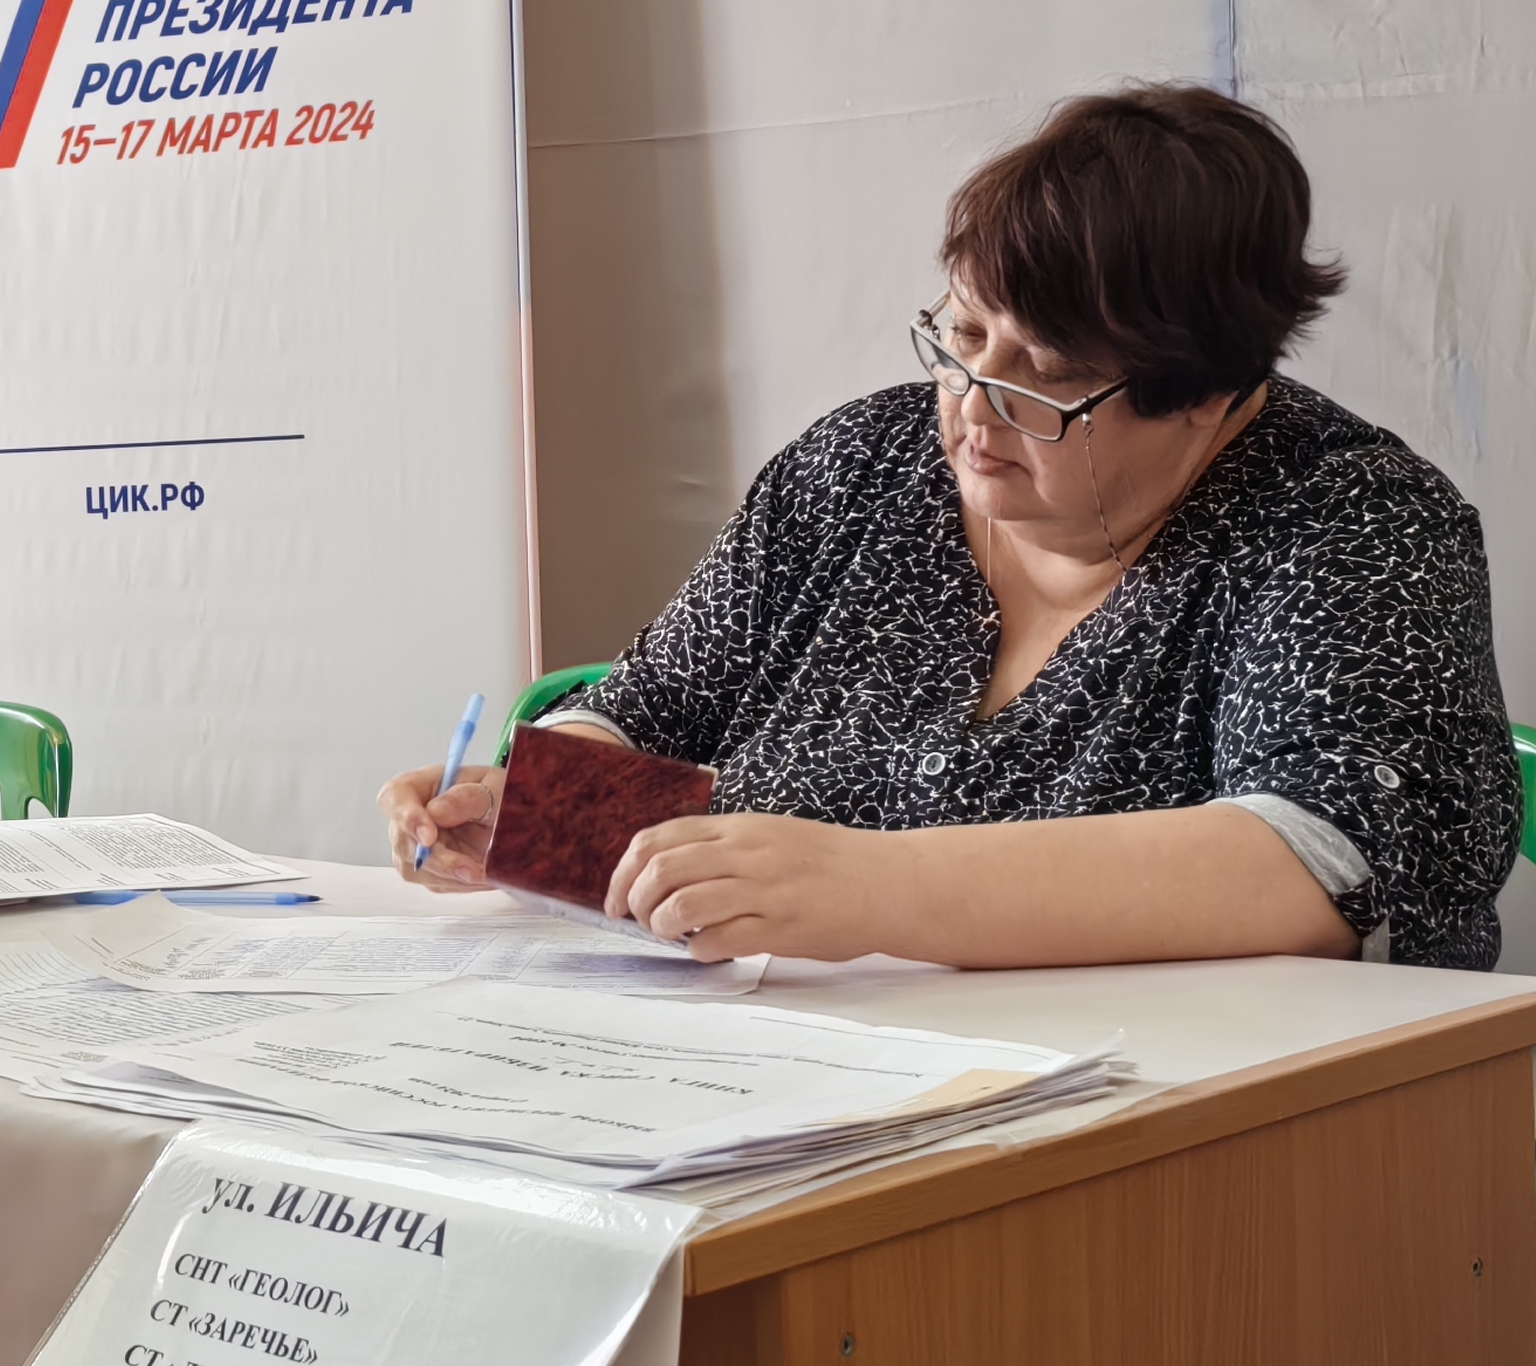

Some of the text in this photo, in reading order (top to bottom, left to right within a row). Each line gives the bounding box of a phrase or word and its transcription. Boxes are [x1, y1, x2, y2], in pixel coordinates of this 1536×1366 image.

[72, 46, 278, 109] РОССИИ
[156, 107, 279, 156] МАРТА
[285, 100, 375, 147] 2024
[85, 481, 205, 519] ЦИК.РФ
[201, 1177, 448, 1258] ул. ИЛЬИЧА
[150, 1298, 187, 1327] СТ
[173, 1252, 350, 1319] СНТ «ГЕОЛОГ»
